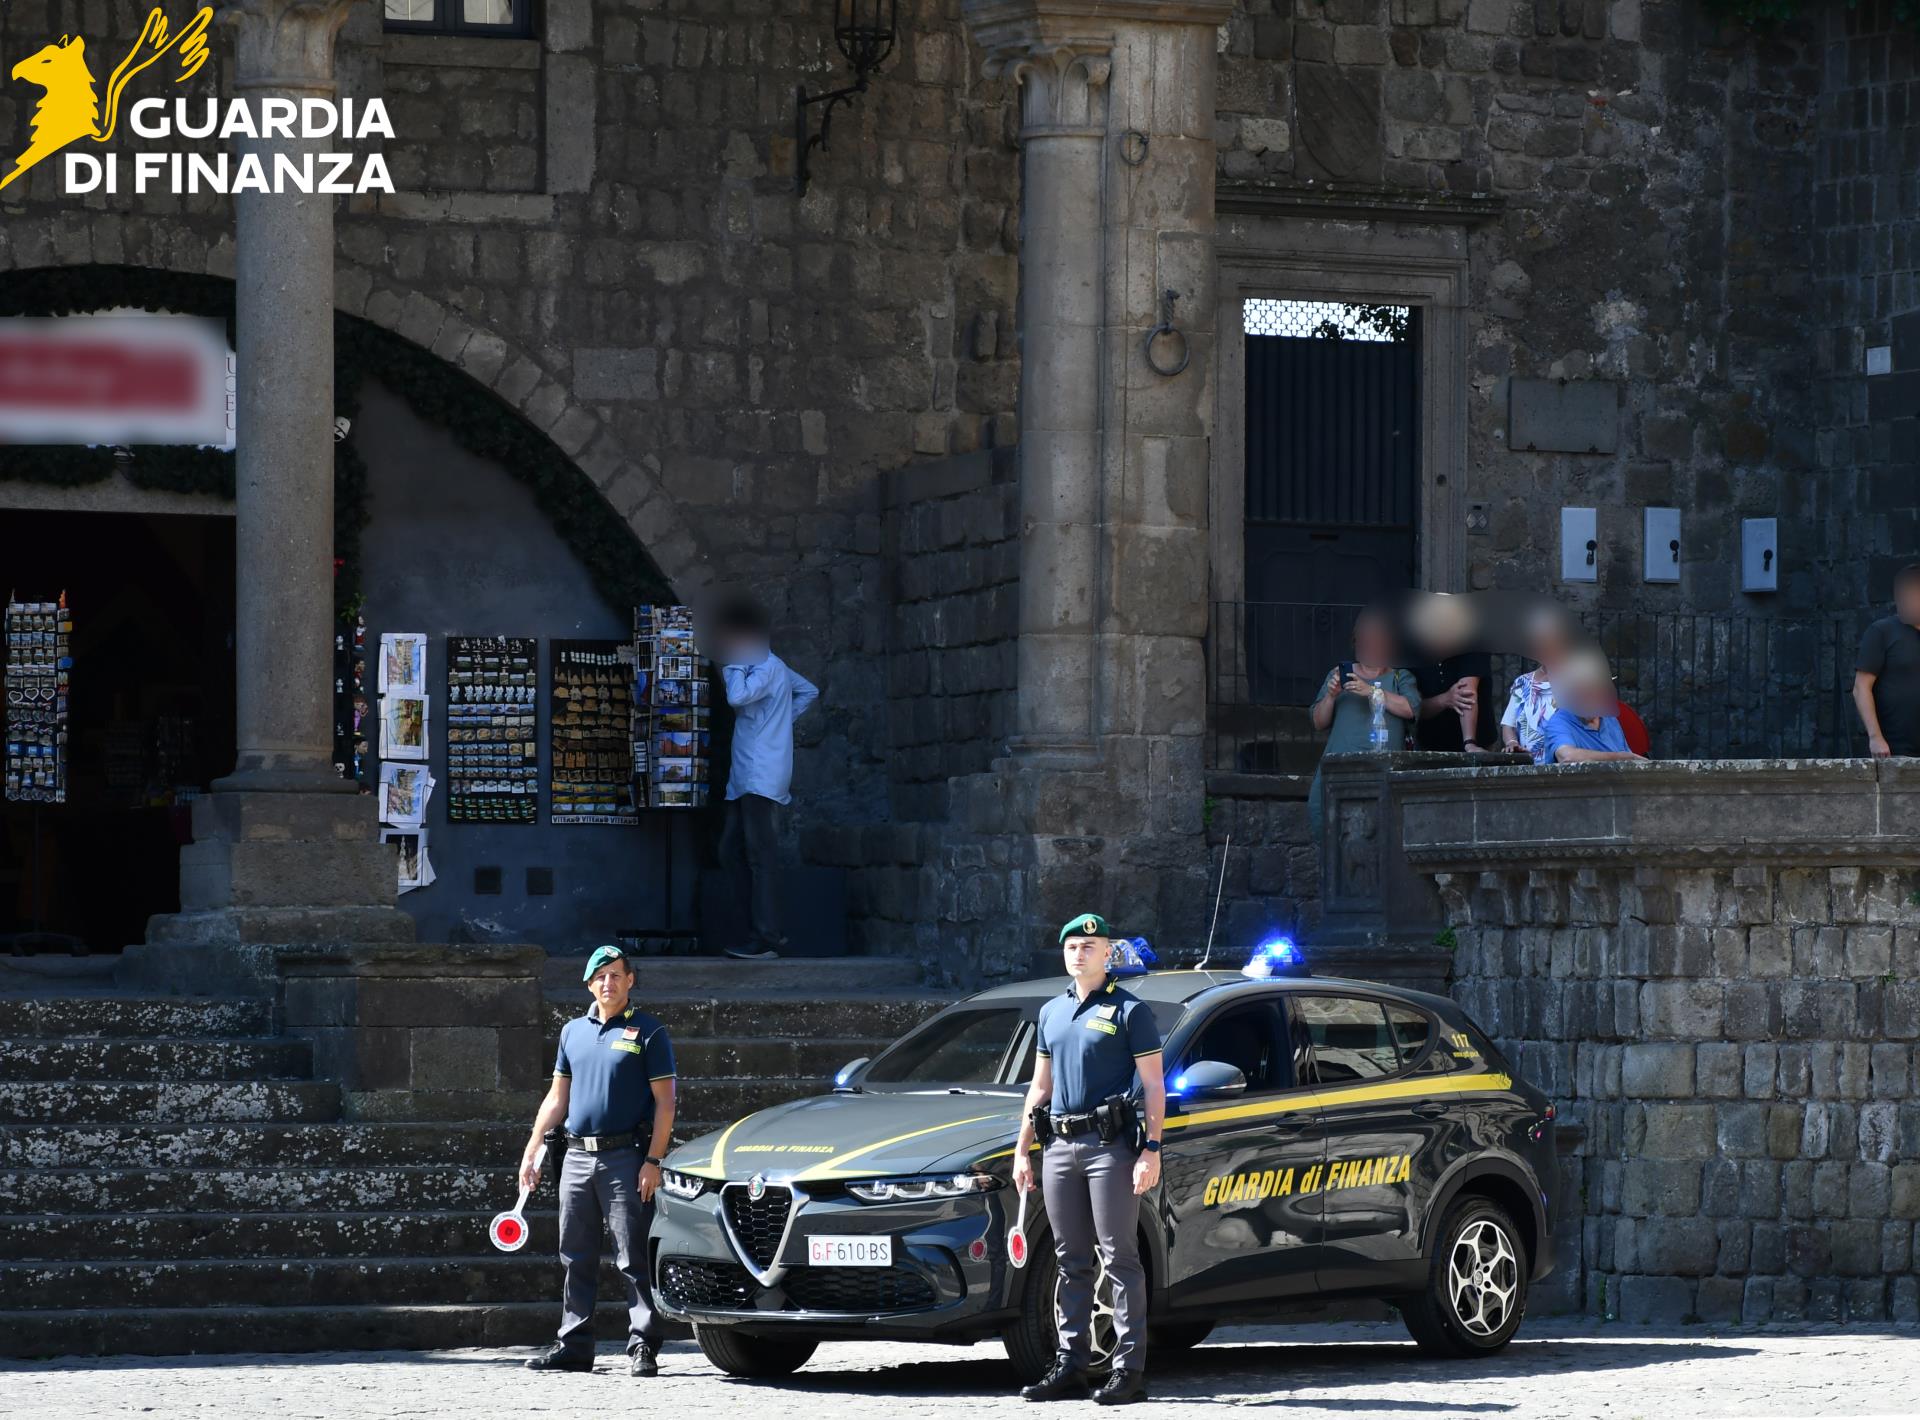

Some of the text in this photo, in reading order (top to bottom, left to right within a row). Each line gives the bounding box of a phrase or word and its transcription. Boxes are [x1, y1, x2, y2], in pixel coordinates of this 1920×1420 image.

[1451, 1032, 1470, 1048] 117
[1203, 1154, 1411, 1206] GUARDIA di FINANZA
